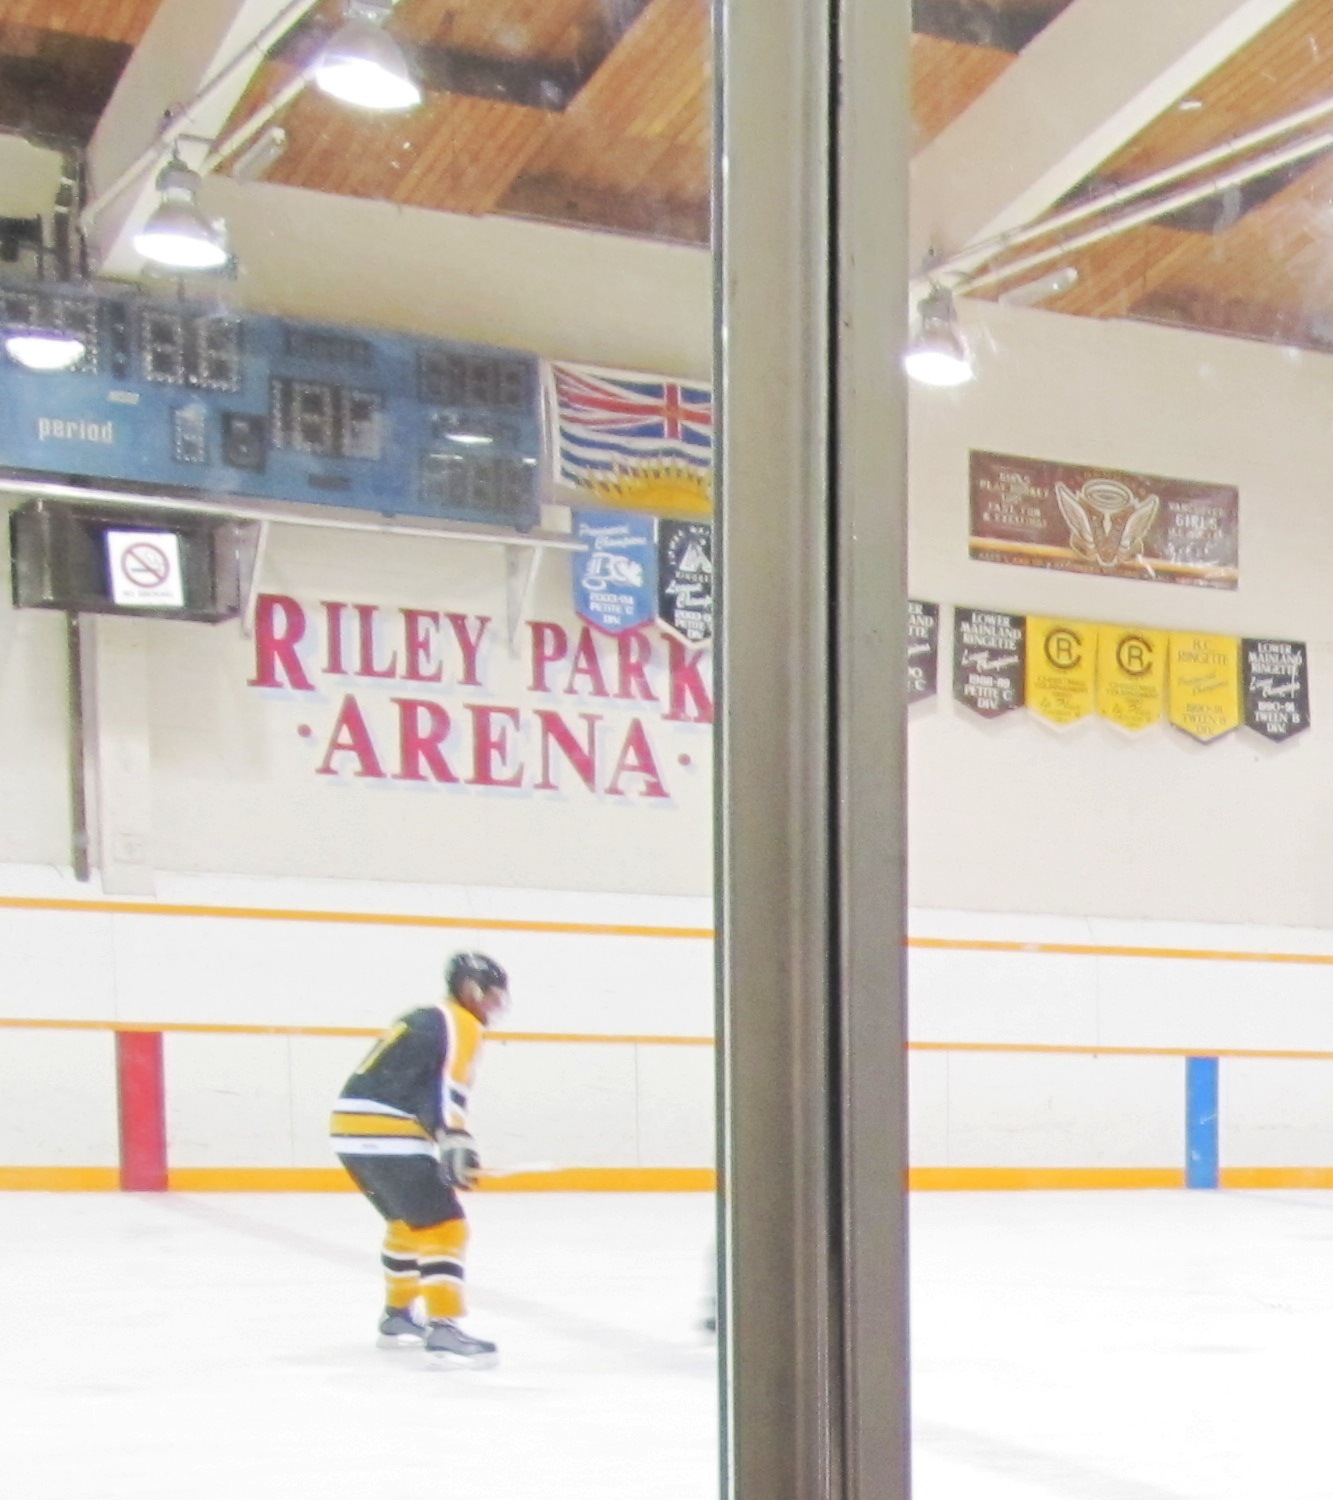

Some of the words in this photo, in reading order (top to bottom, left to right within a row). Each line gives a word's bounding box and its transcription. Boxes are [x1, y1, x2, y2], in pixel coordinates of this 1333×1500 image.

[37, 416, 114, 444] period
[1175, 513, 1218, 531] GIRLS
[971, 612, 1011, 627] LOWER
[960, 621, 1022, 641] MAINLAND
[962, 632, 1018, 651] RINGETTE
[1257, 642, 1292, 653] LOWER
[247, 592, 492, 692] RILEY
[525, 618, 714, 724] PARK
[1177, 650, 1228, 665] RINGETTE
[1248, 651, 1303, 666] MAINLAND
[1250, 661, 1300, 676] RINGETTE
[963, 683, 999, 699] PETITE
[1183, 712, 1215, 724] TWEEN
[1254, 711, 1289, 723] TWEEN
[315, 693, 671, 798] ARENA
